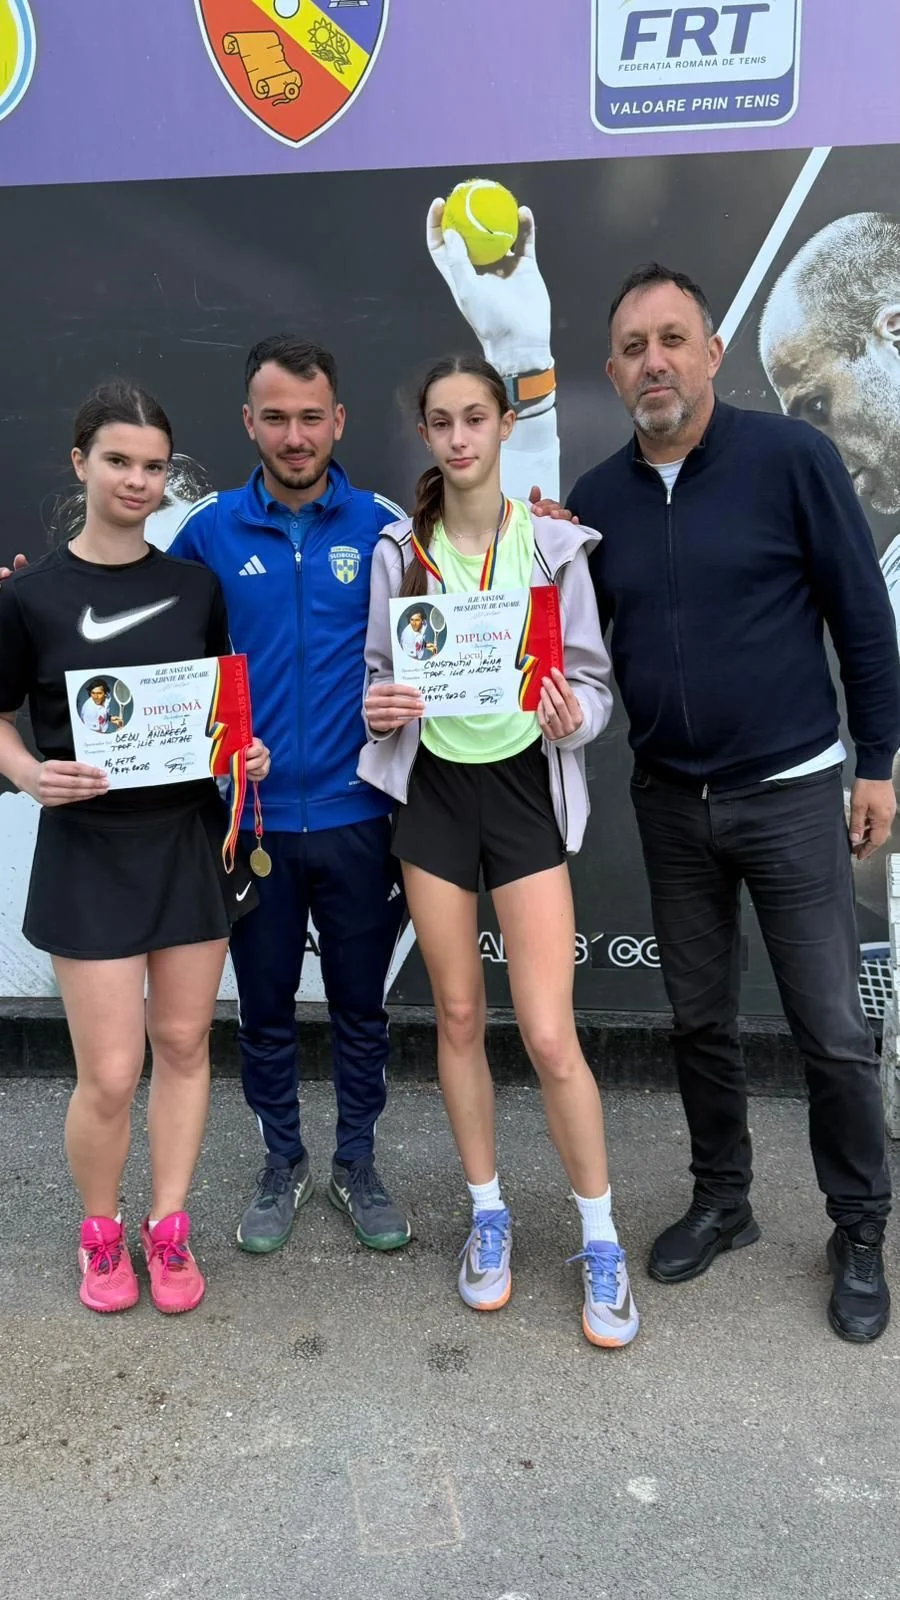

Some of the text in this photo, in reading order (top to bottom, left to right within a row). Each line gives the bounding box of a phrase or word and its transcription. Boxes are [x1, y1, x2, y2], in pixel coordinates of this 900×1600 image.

[620, 3, 770, 61] FRT
[722, 58, 734, 66] DE
[740, 55, 767, 65] TENIS
[610, 93, 780, 115] VALOARE PRIN TENIS
[456, 629, 512, 644] DIPLOMĂ
[459, 650, 483, 660] Locul
[143, 698, 202, 716] DIPLOMĂ
